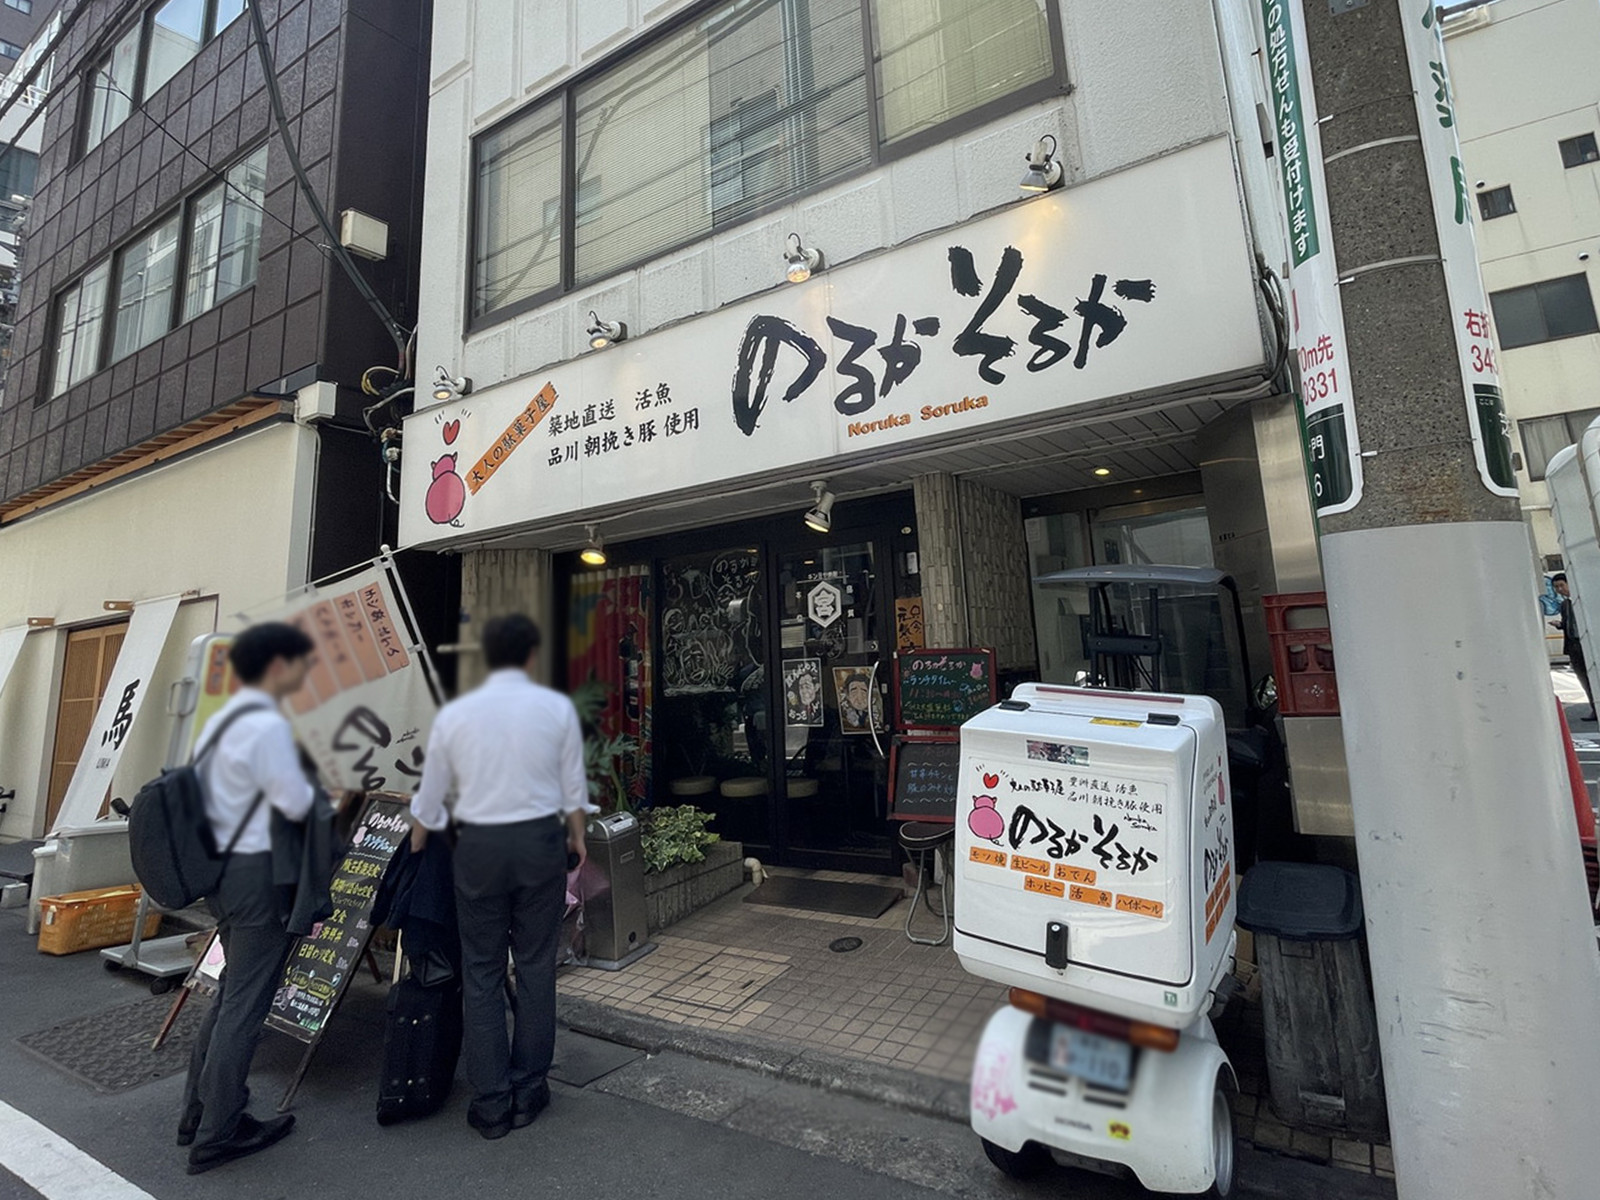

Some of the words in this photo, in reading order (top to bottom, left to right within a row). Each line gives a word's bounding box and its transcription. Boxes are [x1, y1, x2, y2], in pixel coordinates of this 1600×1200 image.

[1265, 0, 1310, 257] の処方せんも受付けます
[731, 245, 1156, 436] のるかそるか
[472, 393, 550, 484] 大人の駄菓子屋
[547, 440, 579, 467] 品川
[584, 419, 658, 458] 朝挽き豚
[664, 407, 699, 438] 使用
[548, 398, 616, 437] 築地直送
[635, 382, 672, 412] 活魚
[847, 413, 911, 437] Noruka
[920, 395, 989, 420] Soruka
[1009, 804, 1158, 875] のるかそるか
[1056, 866, 1095, 884] おでん
